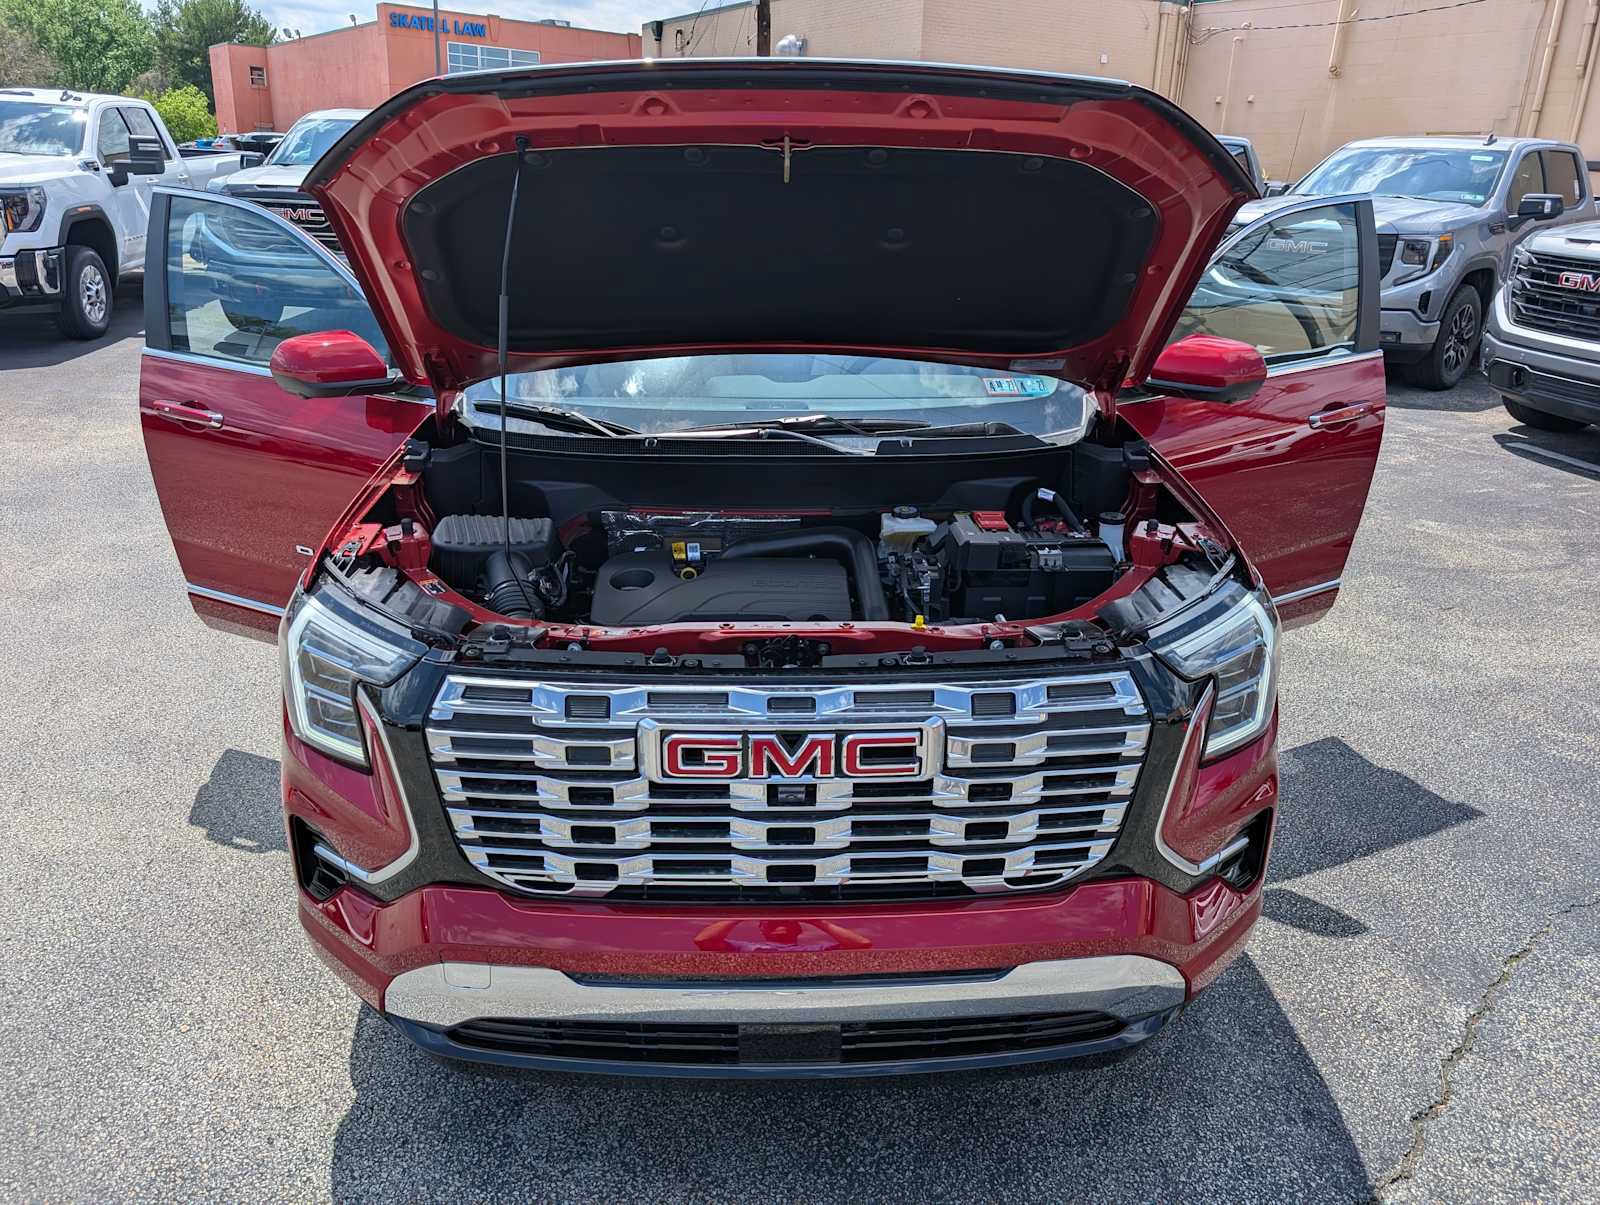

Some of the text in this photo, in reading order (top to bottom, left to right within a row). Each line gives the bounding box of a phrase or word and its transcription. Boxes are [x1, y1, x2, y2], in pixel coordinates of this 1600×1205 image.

[454, 20, 485, 37] LAW
[1266, 238, 1329, 256] GMC
[1558, 271, 1600, 293] GM
[663, 733, 922, 778] GMC
